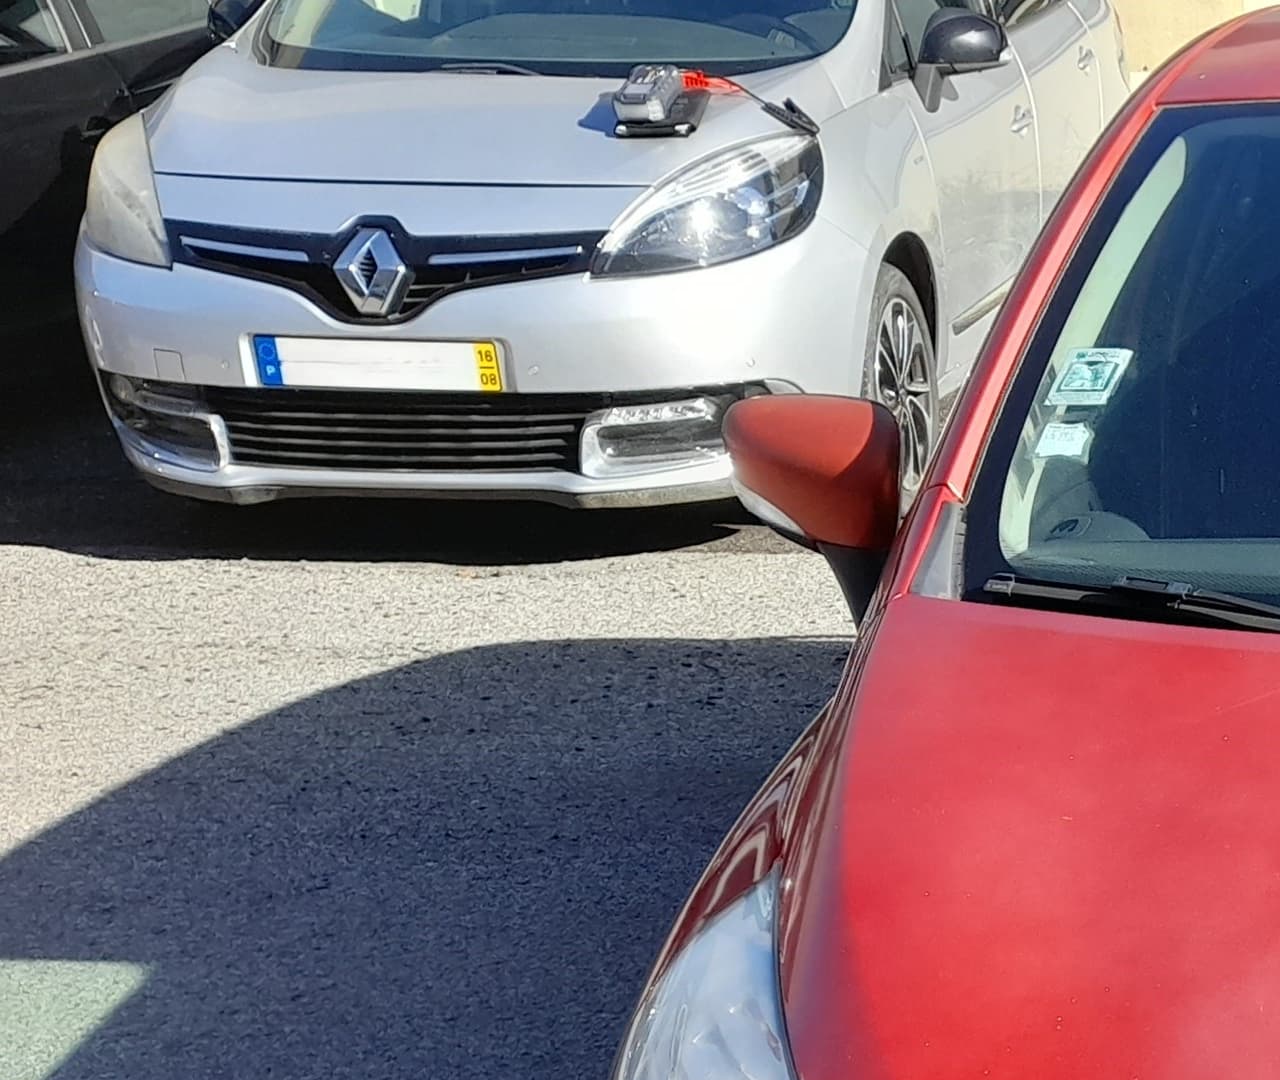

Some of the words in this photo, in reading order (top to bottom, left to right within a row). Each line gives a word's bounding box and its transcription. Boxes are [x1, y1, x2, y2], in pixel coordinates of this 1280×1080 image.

[477, 350, 493, 363] 16
[266, 365, 276, 376] P
[480, 373, 497, 386] 08
